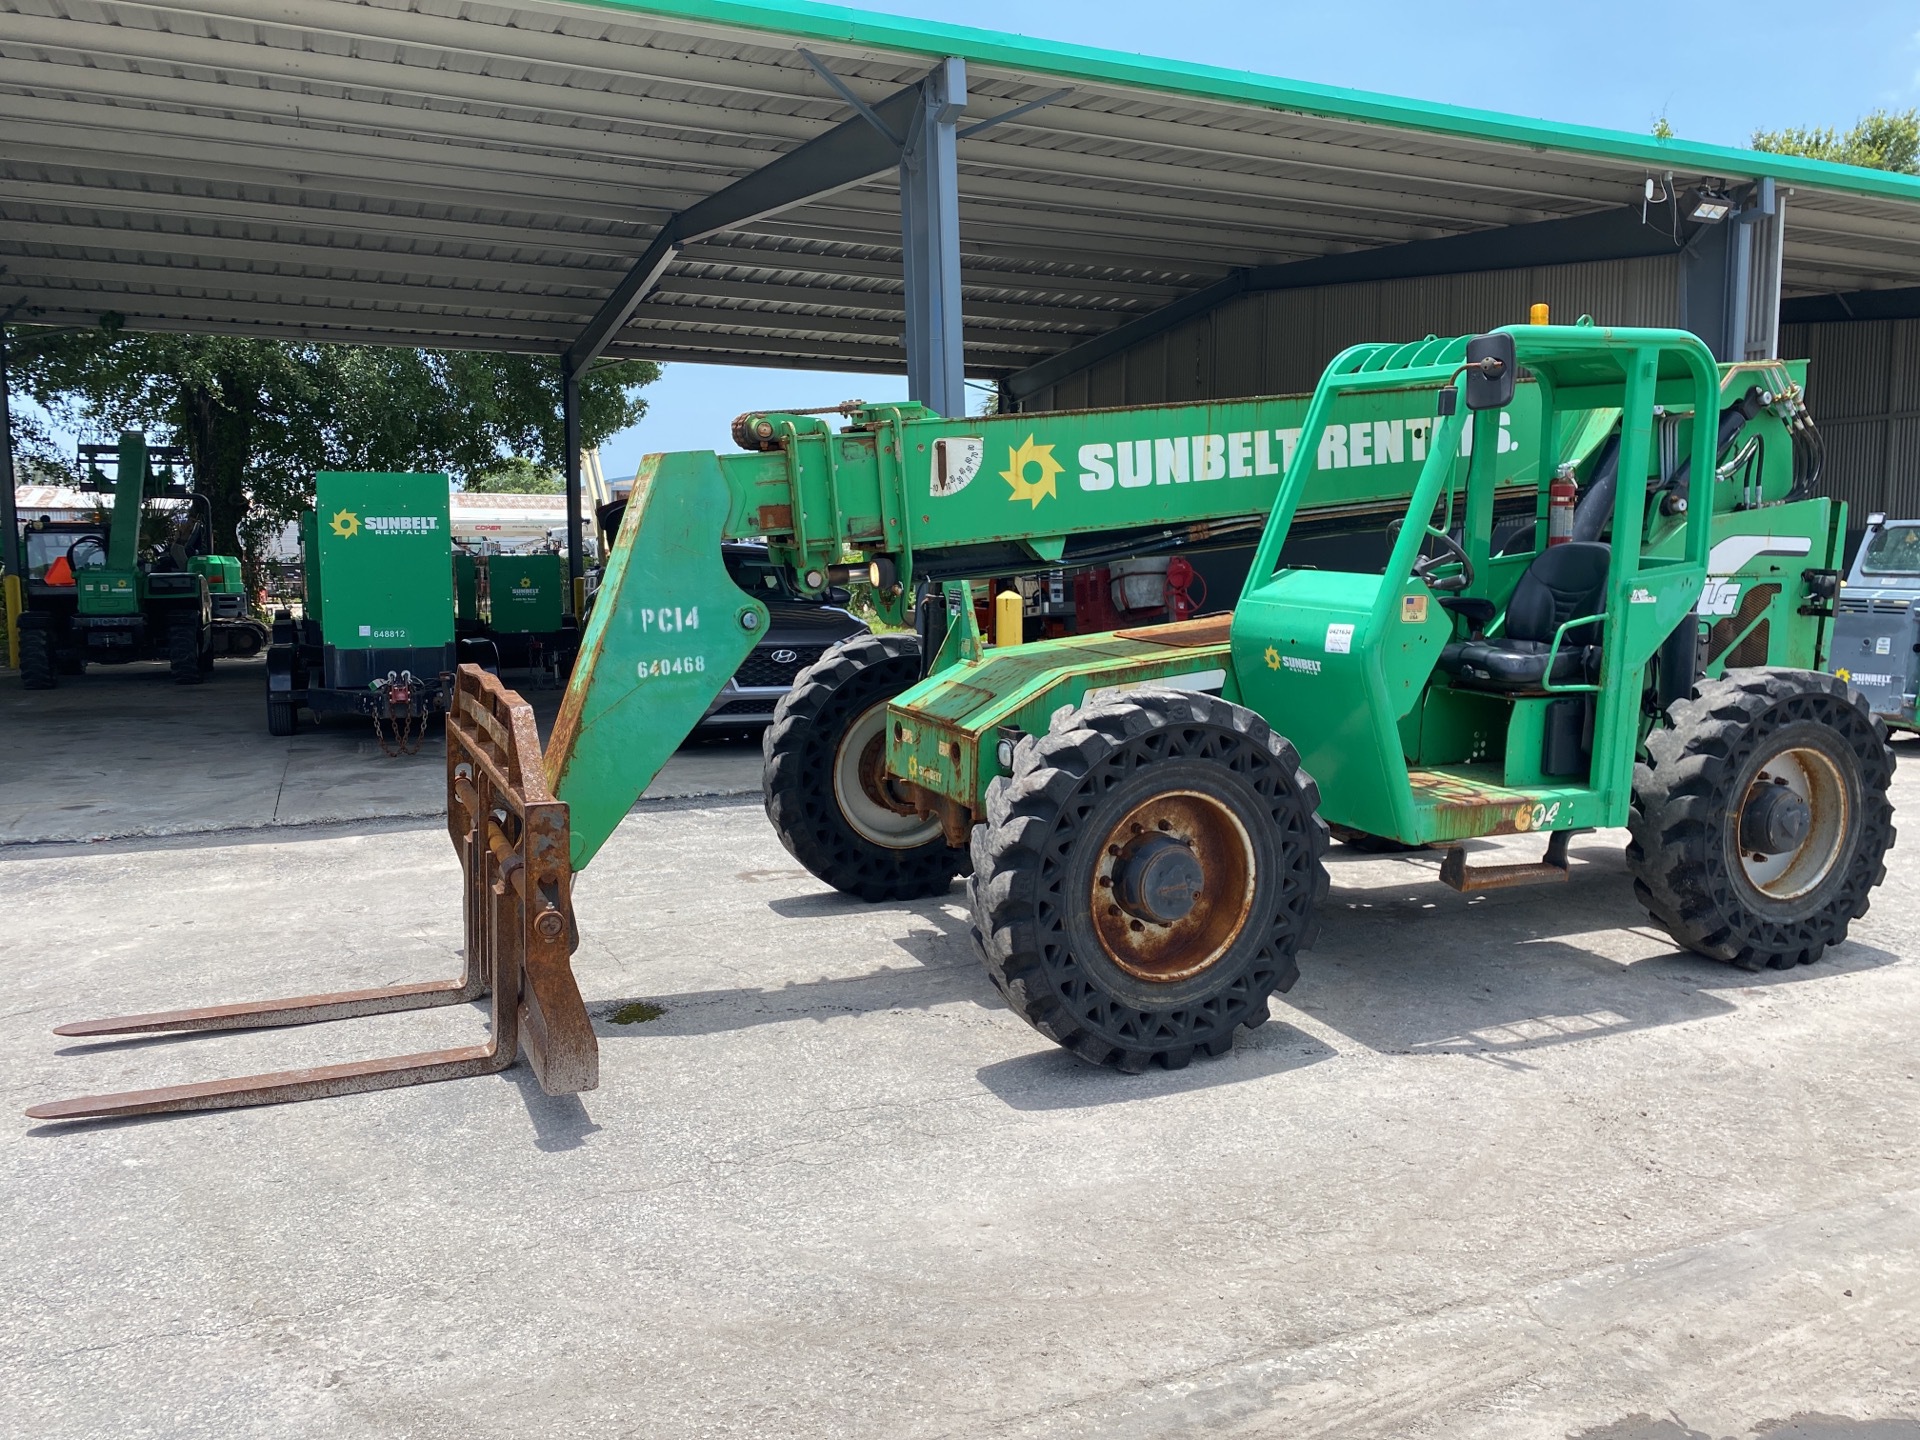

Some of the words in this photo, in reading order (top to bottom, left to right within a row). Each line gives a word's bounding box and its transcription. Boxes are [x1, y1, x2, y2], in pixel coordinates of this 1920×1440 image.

[1078, 427, 1303, 491] SUNBELT
[1318, 411, 1519, 470] RENTS.
[364, 516, 438, 530] SUNBELT
[373, 630, 406, 638] 648812
[637, 655, 706, 679] 640468
[1282, 656, 1322, 672] SUNBELT
[1851, 672, 1892, 684] SUNBELT
